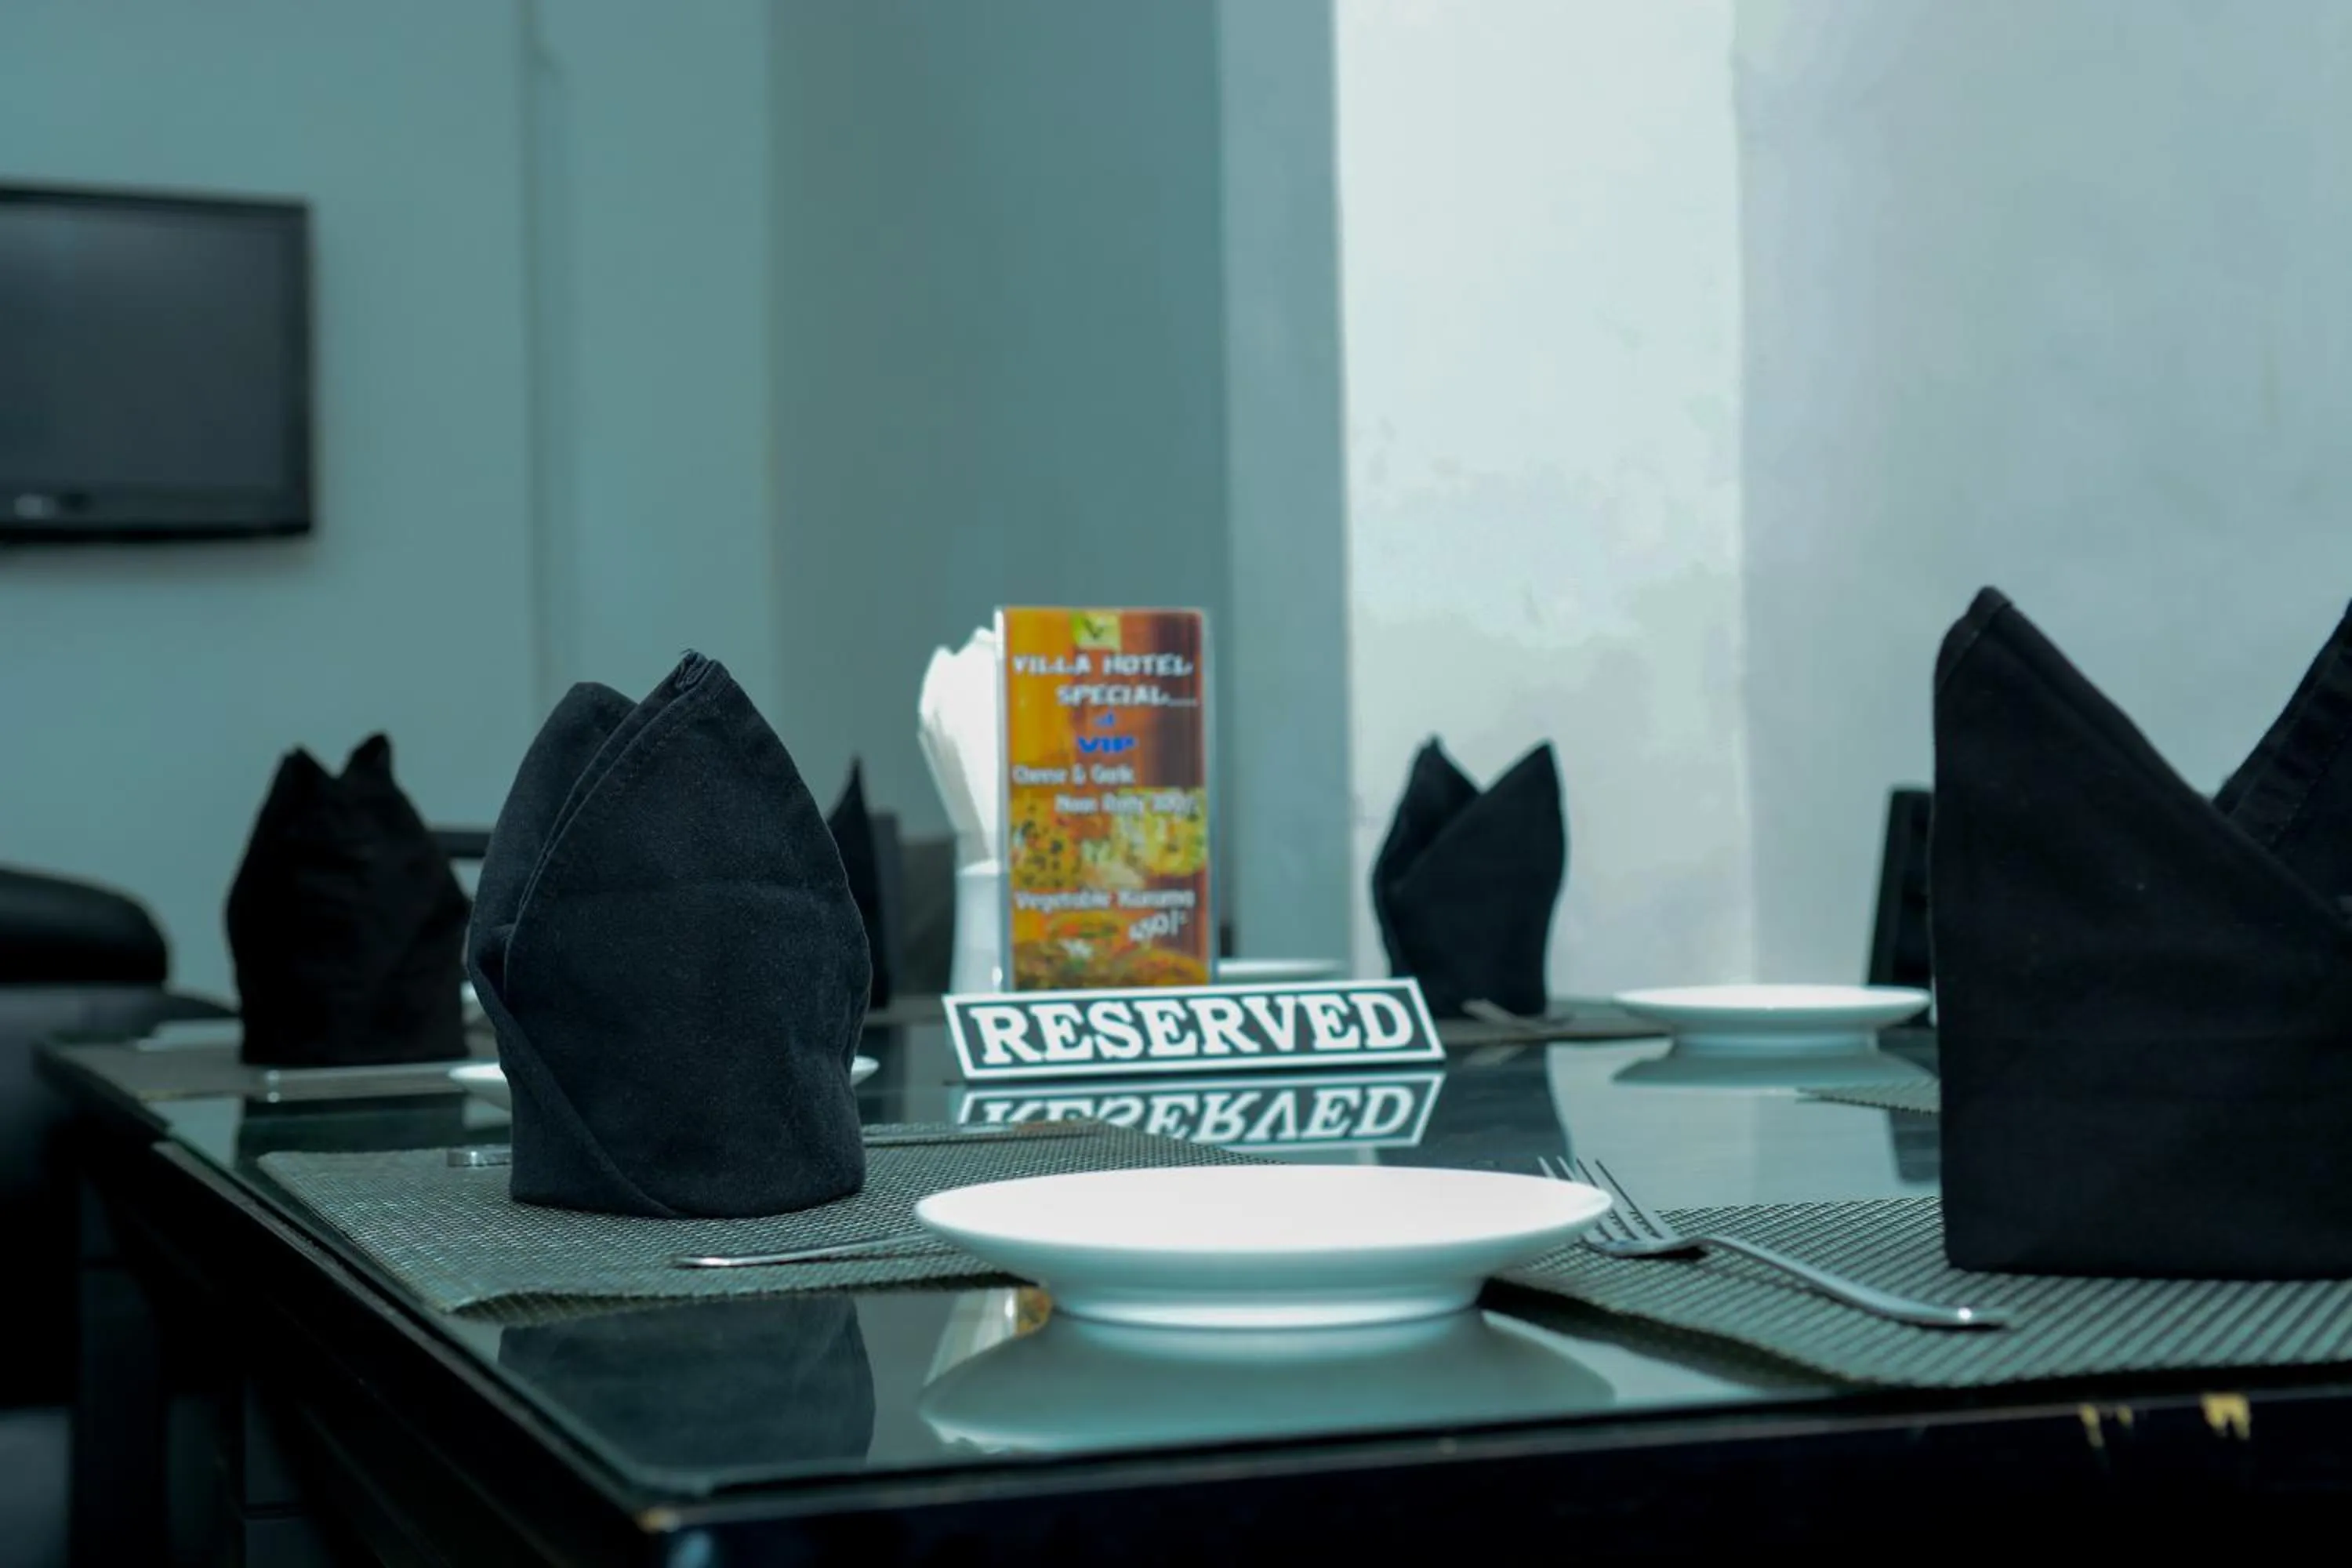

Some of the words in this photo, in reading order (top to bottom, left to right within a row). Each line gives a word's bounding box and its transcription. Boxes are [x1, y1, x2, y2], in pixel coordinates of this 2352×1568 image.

[1013, 655, 1091, 675] VILLA
[1102, 654, 1193, 676] HOTEL
[1077, 736, 1137, 753] VIP
[968, 992, 1415, 1065] RESERVED
